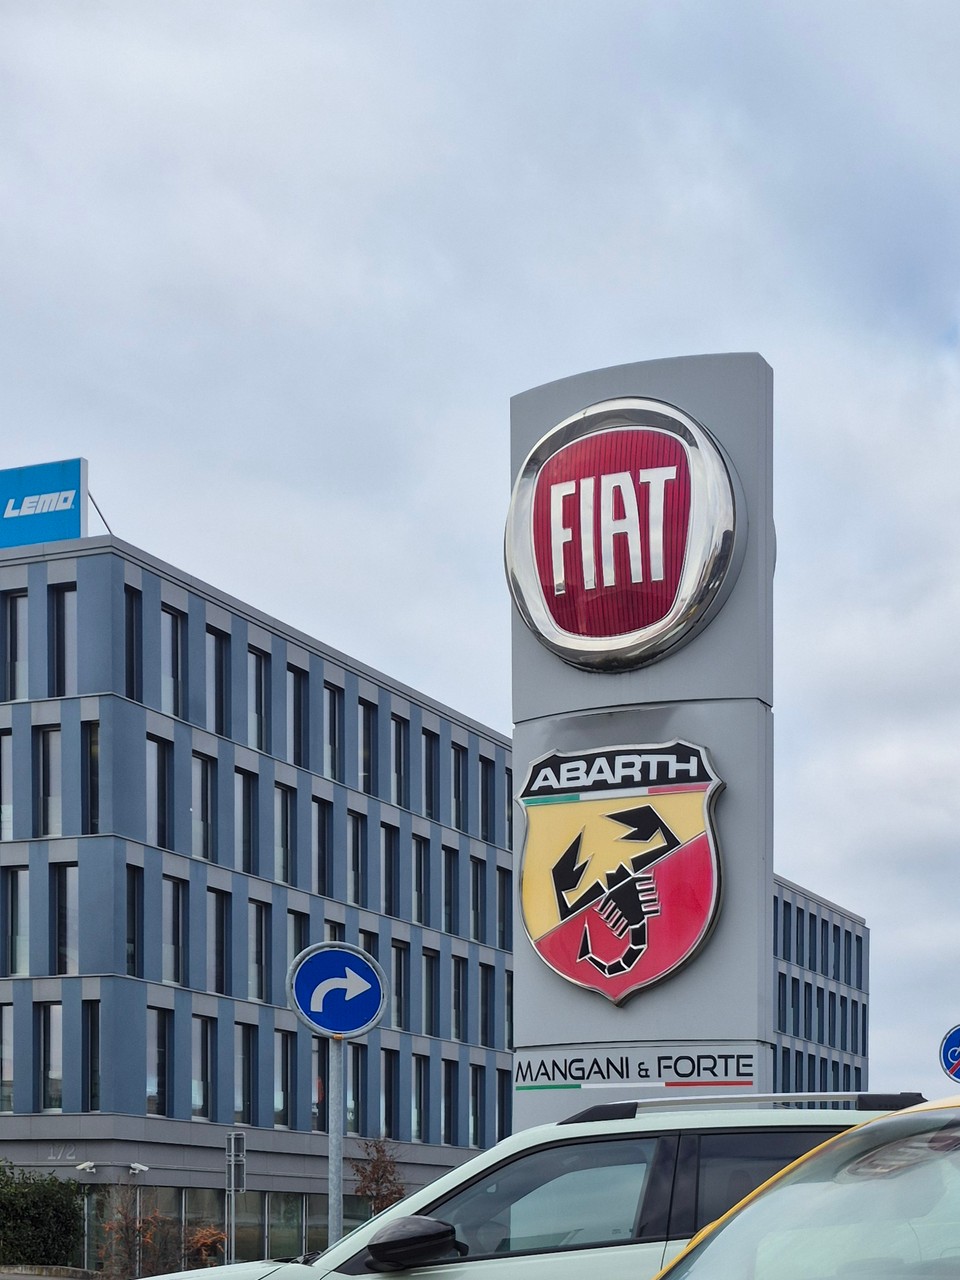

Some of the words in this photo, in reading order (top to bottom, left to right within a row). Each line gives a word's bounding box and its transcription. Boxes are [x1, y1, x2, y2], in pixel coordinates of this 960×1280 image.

[3, 489, 76, 518] LEMO
[550, 465, 678, 596] FIAT
[529, 753, 699, 791] ABARTH
[515, 1056, 630, 1082] MANGANI
[637, 1061, 651, 1078] &
[657, 1054, 754, 1078] FORTE
